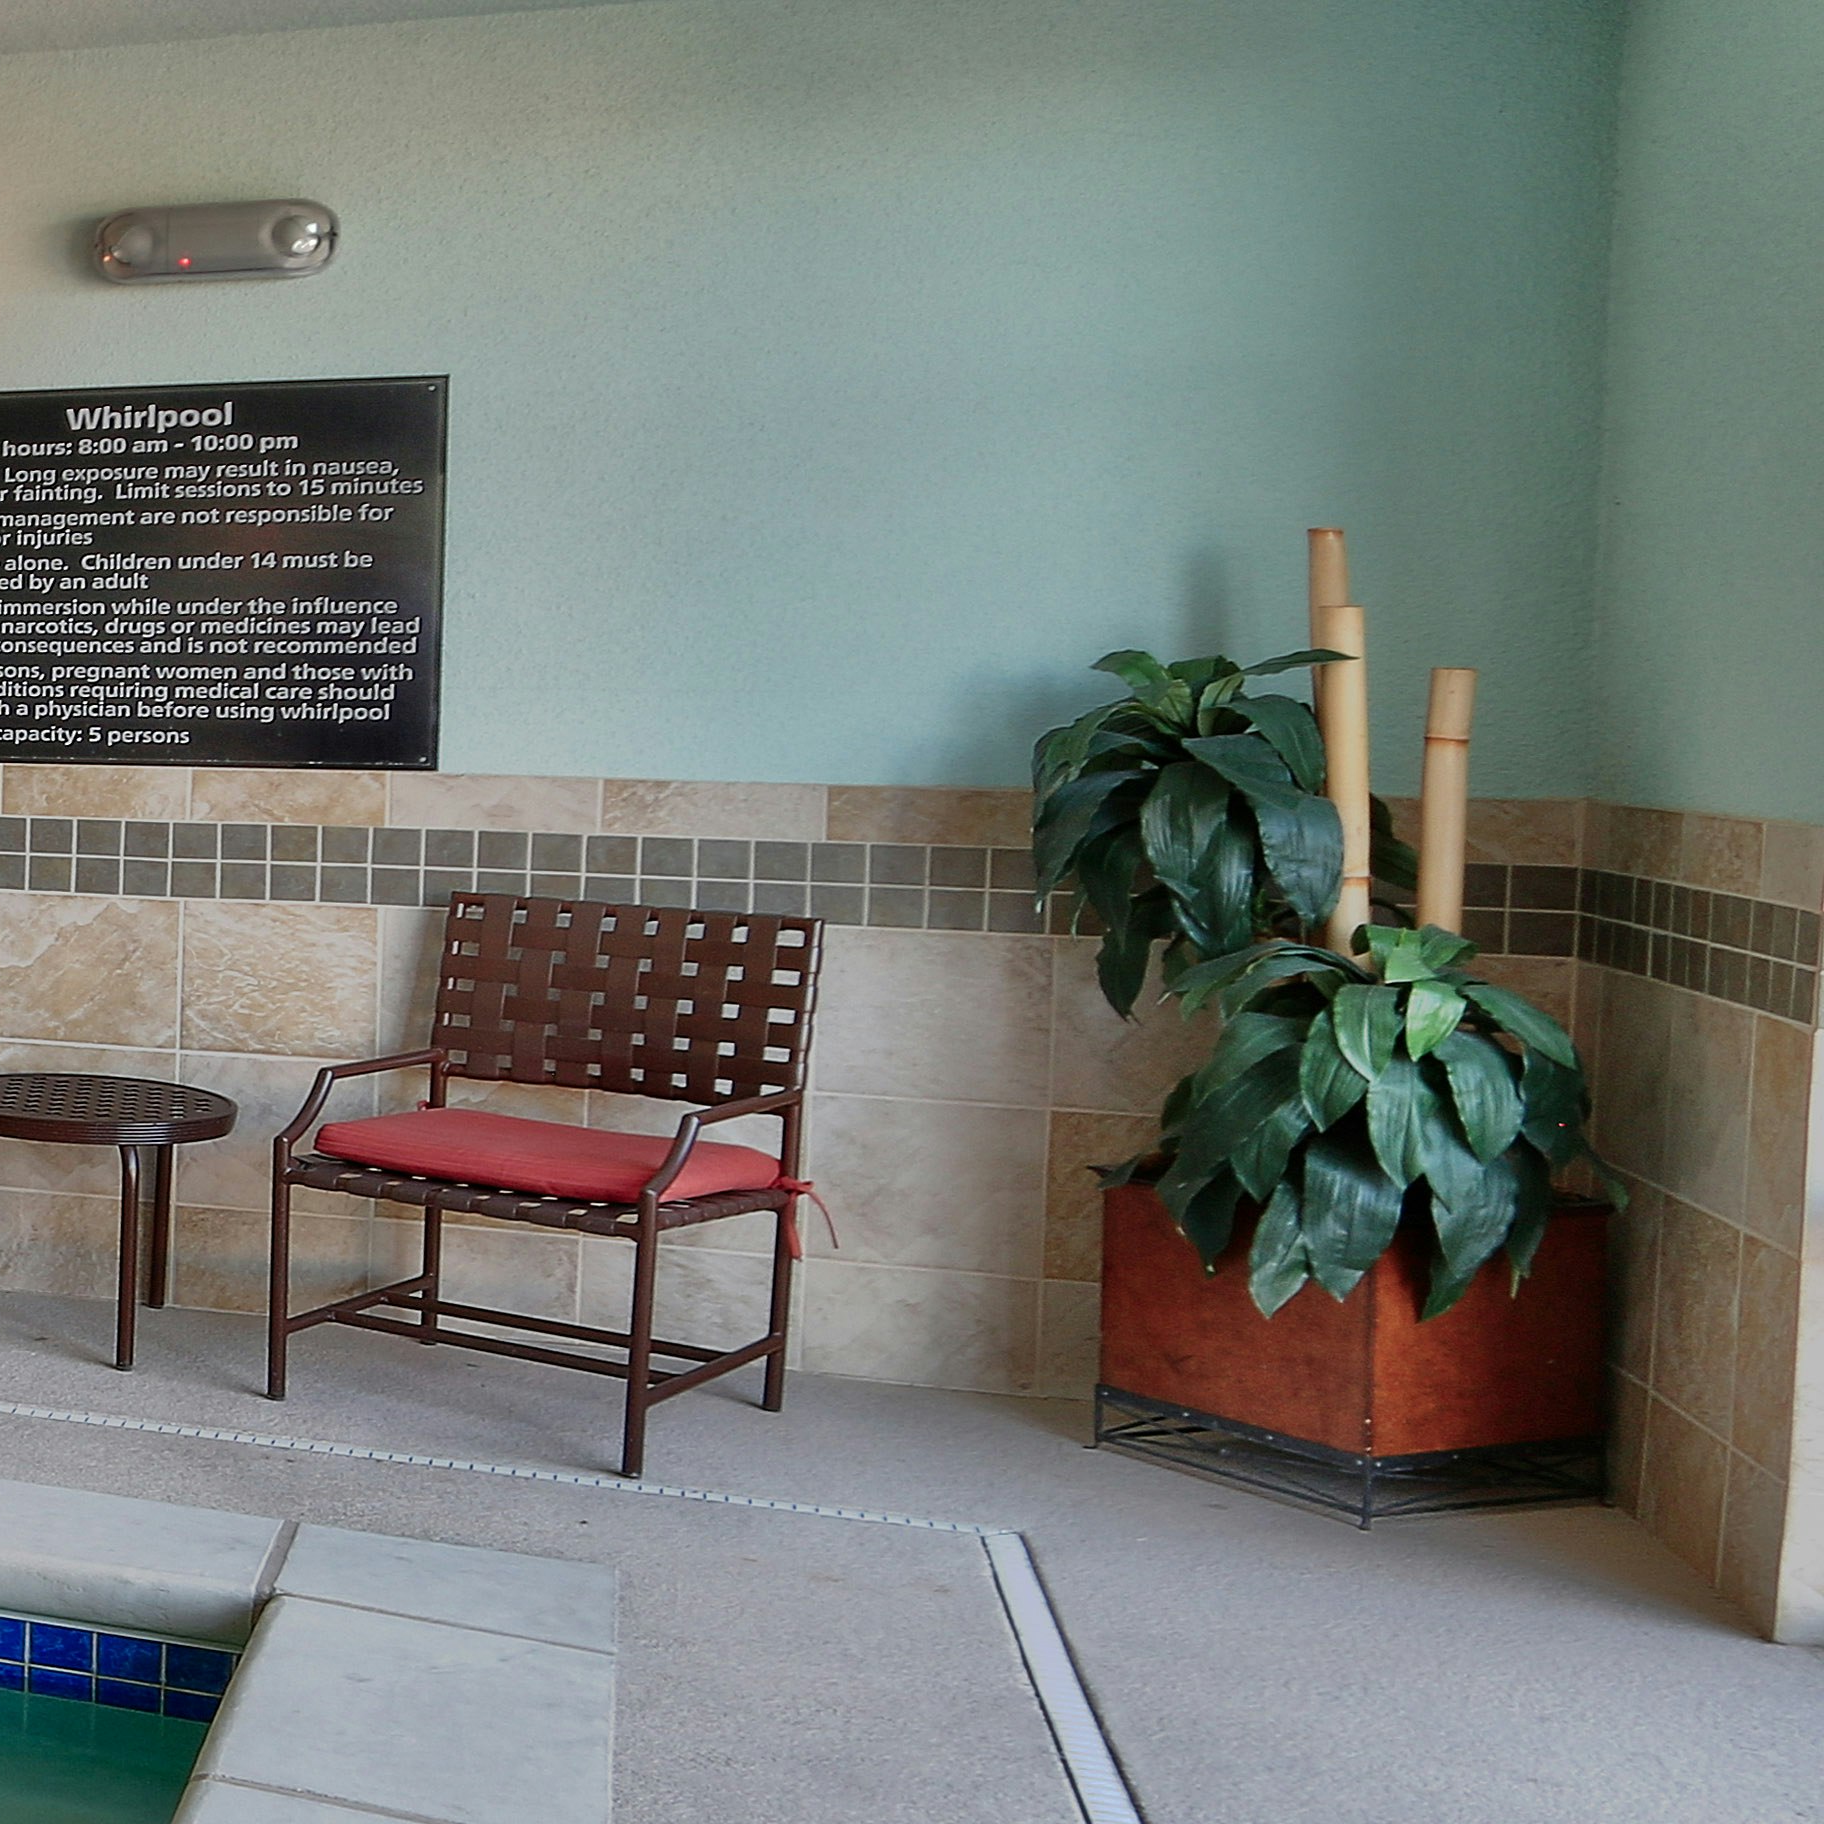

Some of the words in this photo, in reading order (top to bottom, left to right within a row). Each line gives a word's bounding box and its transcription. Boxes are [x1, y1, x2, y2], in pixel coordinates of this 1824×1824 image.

[65, 401, 234, 433] Whirlpool
[2, 440, 73, 457] hours:
[78, 437, 126, 455] 8:00
[132, 439, 168, 453] am
[190, 434, 253, 451] 10:00
[259, 434, 299, 453] pm
[4, 466, 56, 483] Long
[61, 465, 158, 484] exposure
[164, 463, 210, 482] may
[215, 460, 279, 478] result
[285, 459, 305, 476] in
[312, 460, 400, 477] nausea,
[13, 485, 103, 504] fainting.
[115, 482, 170, 500] Limit
[174, 480, 261, 499] sessions
[266, 481, 292, 497] to
[299, 479, 325, 496] 15
[330, 477, 424, 496] minutes
[139, 509, 176, 526] are
[181, 508, 220, 525] not
[225, 504, 353, 526] responsible
[358, 503, 394, 521] for
[16, 529, 93, 549] injuries
[4, 555, 69, 572] alone.
[81, 553, 171, 570] Children
[178, 552, 244, 570] under
[252, 552, 277, 569] 14
[282, 552, 338, 569] must
[343, 550, 374, 568] be
[29, 574, 54, 593] by
[59, 576, 85, 590] an
[92, 573, 149, 590] adult
[111, 598, 171, 615] while
[177, 598, 243, 615] under
[248, 598, 286, 615] the
[291, 597, 398, 614] influence
[1, 619, 99, 636] narcotics,
[104, 618, 166, 638] drugs
[170, 621, 195, 635] or
[201, 617, 311, 635] medicines
[316, 620, 365, 638] may
[370, 617, 421, 635] lead
[139, 636, 181, 654] and
[187, 636, 204, 654] is
[209, 638, 249, 654] not
[253, 636, 417, 654] recommended
[51, 664, 150, 683] pregnant
[155, 666, 237, 680] women
[243, 663, 287, 680] and
[291, 664, 355, 680] those
[360, 663, 414, 681] with
[70, 682, 168, 702] requiring
[174, 683, 259, 700] medical
[265, 686, 313, 700] care
[317, 683, 395, 701] should
[15, 703, 29, 717] a
[34, 701, 131, 720] physician
[137, 701, 209, 719] before
[215, 703, 275, 722] using
[280, 703, 390, 724] whirlpool
[88, 727, 102, 742] 5
[107, 727, 190, 746] persons
